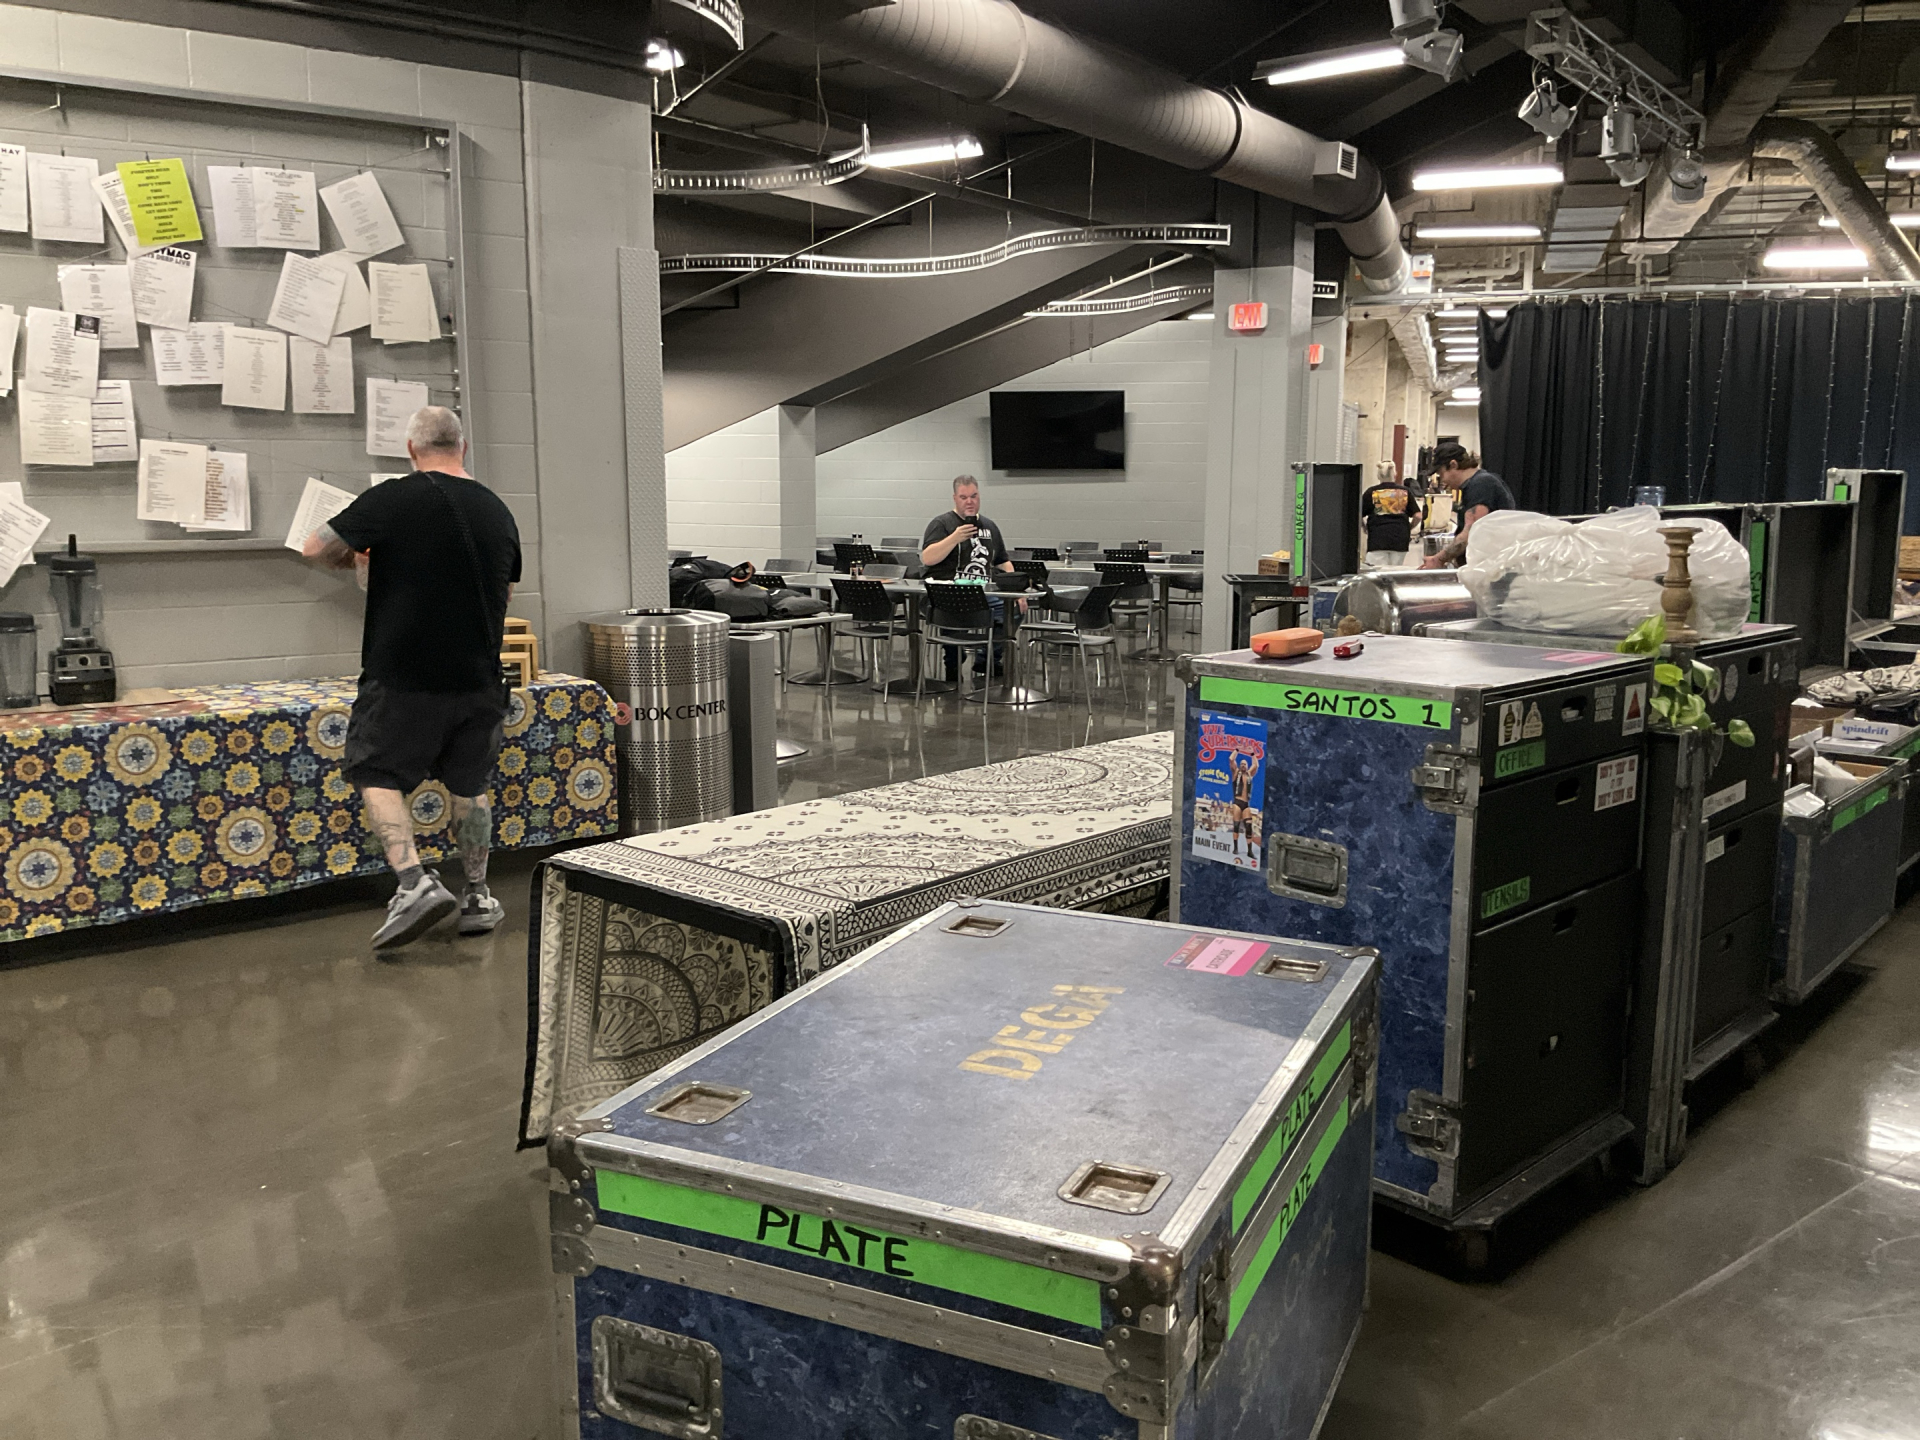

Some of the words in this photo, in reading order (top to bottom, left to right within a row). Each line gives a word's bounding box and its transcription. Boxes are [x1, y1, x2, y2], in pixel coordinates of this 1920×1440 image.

[1234, 303, 1262, 328] EXIT
[635, 707, 672, 720] BOK
[676, 699, 726, 720] CENTER
[1284, 690, 1396, 719] SANTOS
[1422, 704, 1441, 727] 1
[1842, 726, 1889, 735] spindrift
[1199, 734, 1264, 762] SUPERSTARS
[1500, 747, 1533, 772] OFFICE
[1195, 836, 1211, 848] MAIN
[1212, 840, 1231, 853] EVENT
[1280, 1077, 1315, 1154] PLATE
[1279, 1164, 1312, 1243] PLATE
[757, 1203, 914, 1277] PLATE
